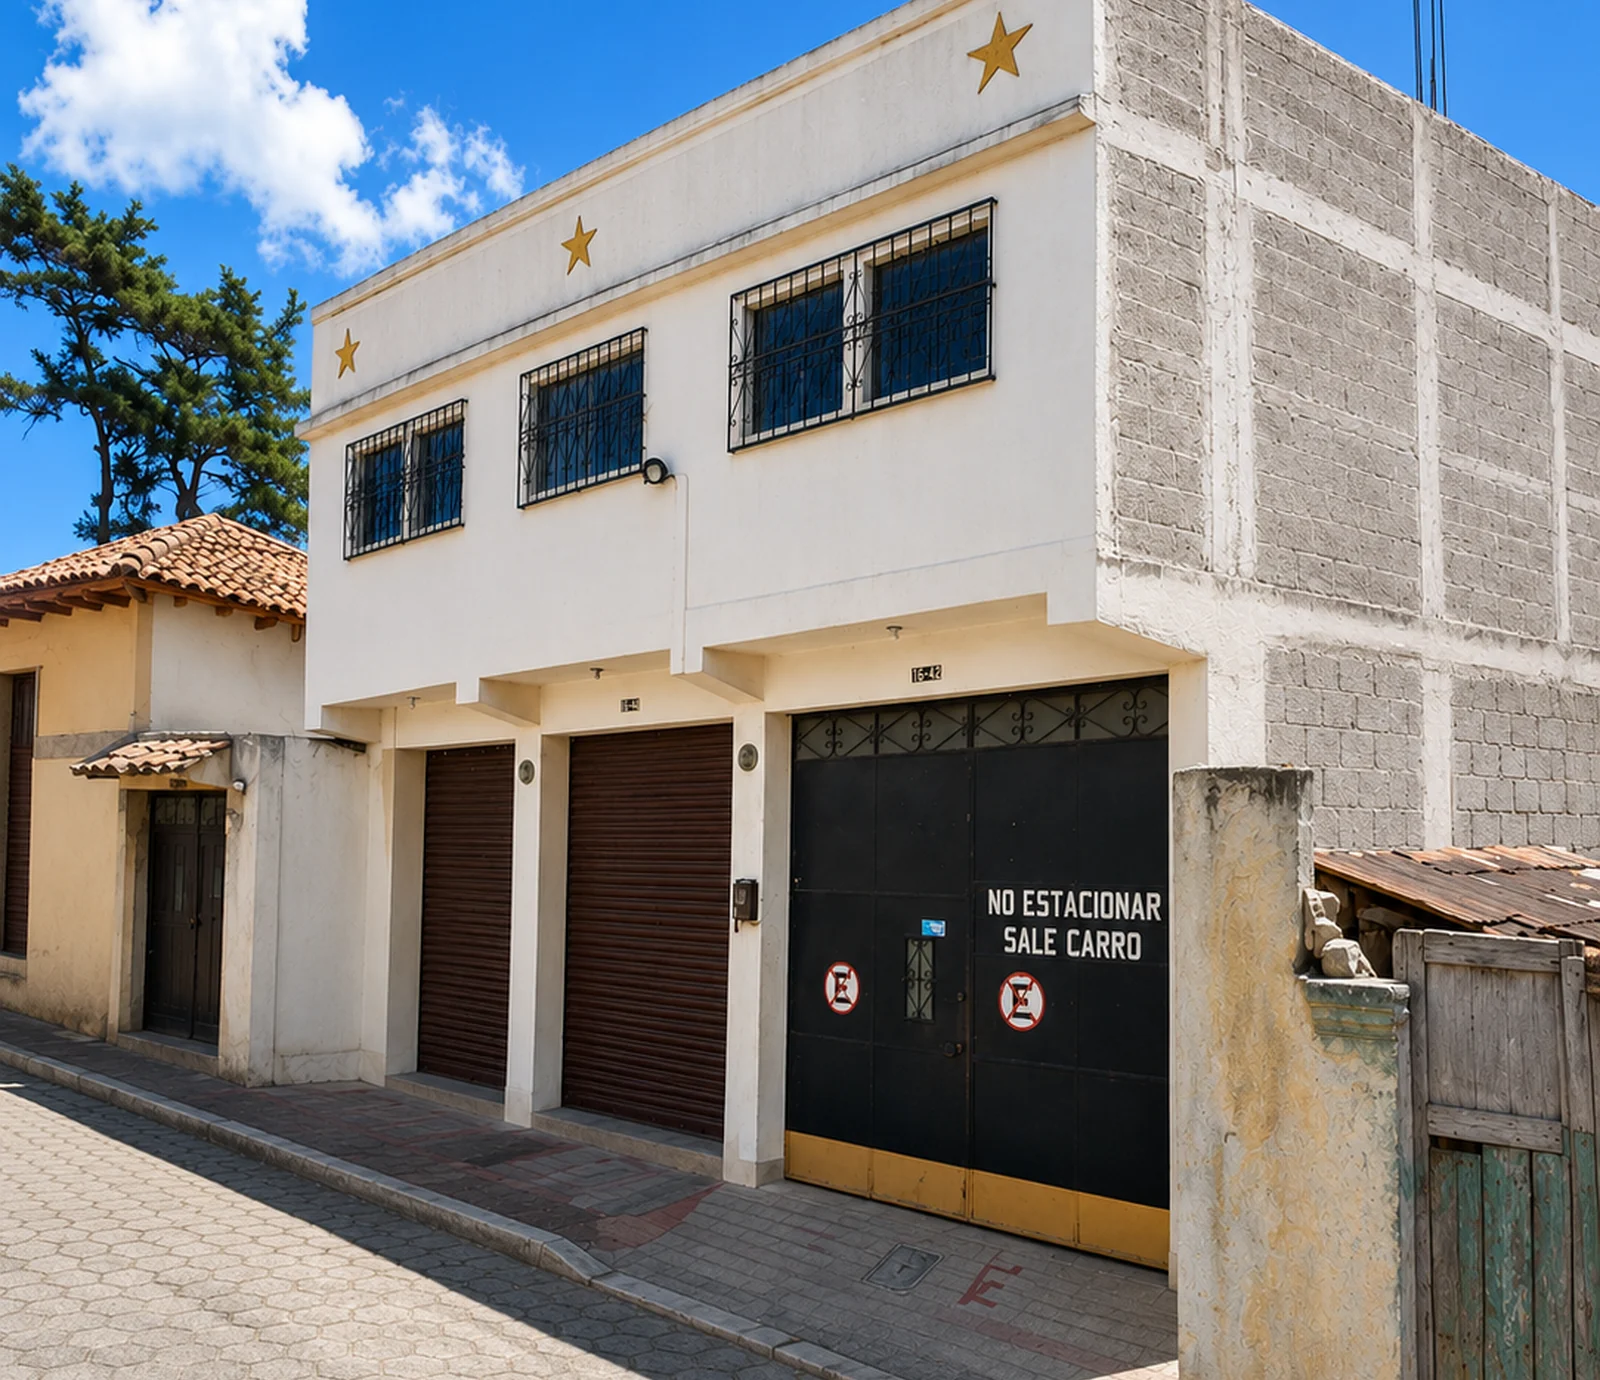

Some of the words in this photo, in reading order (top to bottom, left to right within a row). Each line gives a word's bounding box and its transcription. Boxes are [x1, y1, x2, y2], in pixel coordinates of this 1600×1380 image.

[988, 888, 1015, 916] NO
[1022, 889, 1162, 921] ESTACIONAR
[1004, 926, 1057, 956] SALE
[1066, 928, 1141, 961] CARRO
